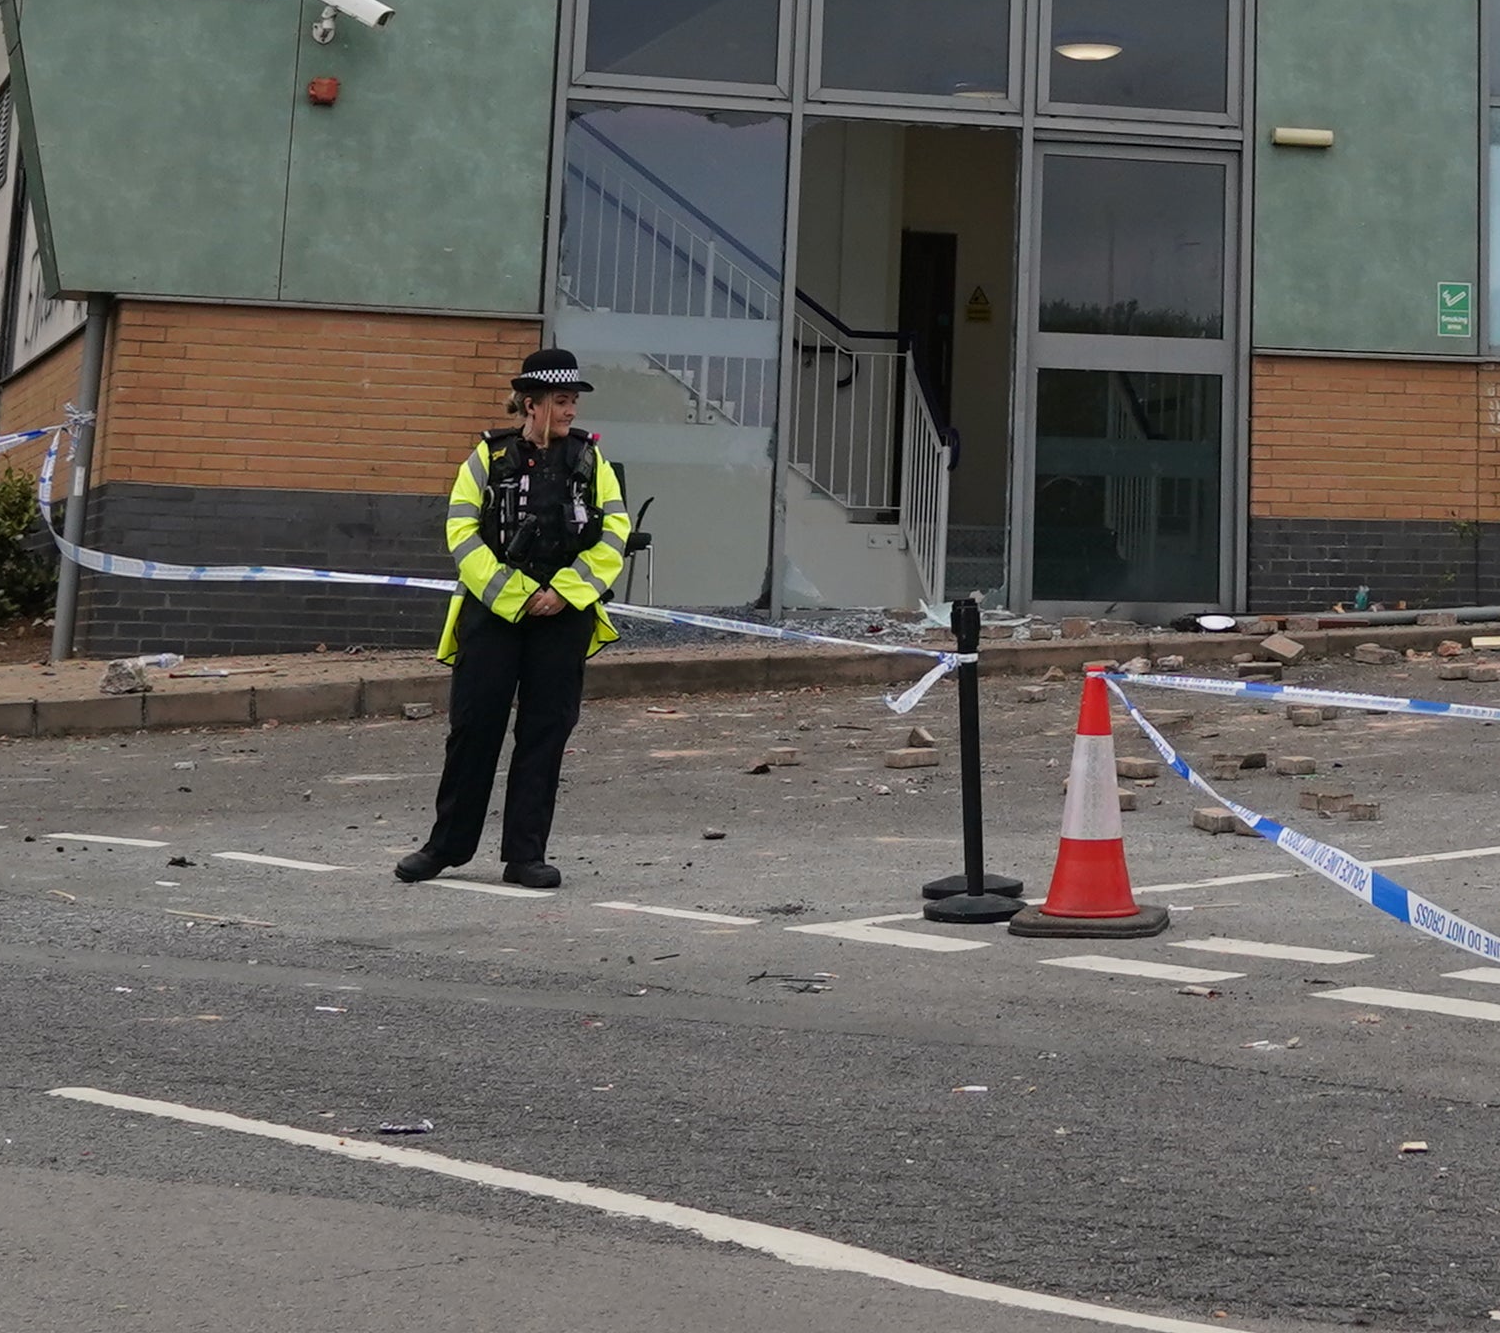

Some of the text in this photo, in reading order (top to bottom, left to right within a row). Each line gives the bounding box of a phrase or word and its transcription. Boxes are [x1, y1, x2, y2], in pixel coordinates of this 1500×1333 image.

[1442, 315, 1468, 325] Smoking
[1339, 860, 1368, 892] POLICE
[1414, 903, 1446, 934] CROSS
[1446, 921, 1465, 944] NOT
[1467, 931, 1481, 952] DO
